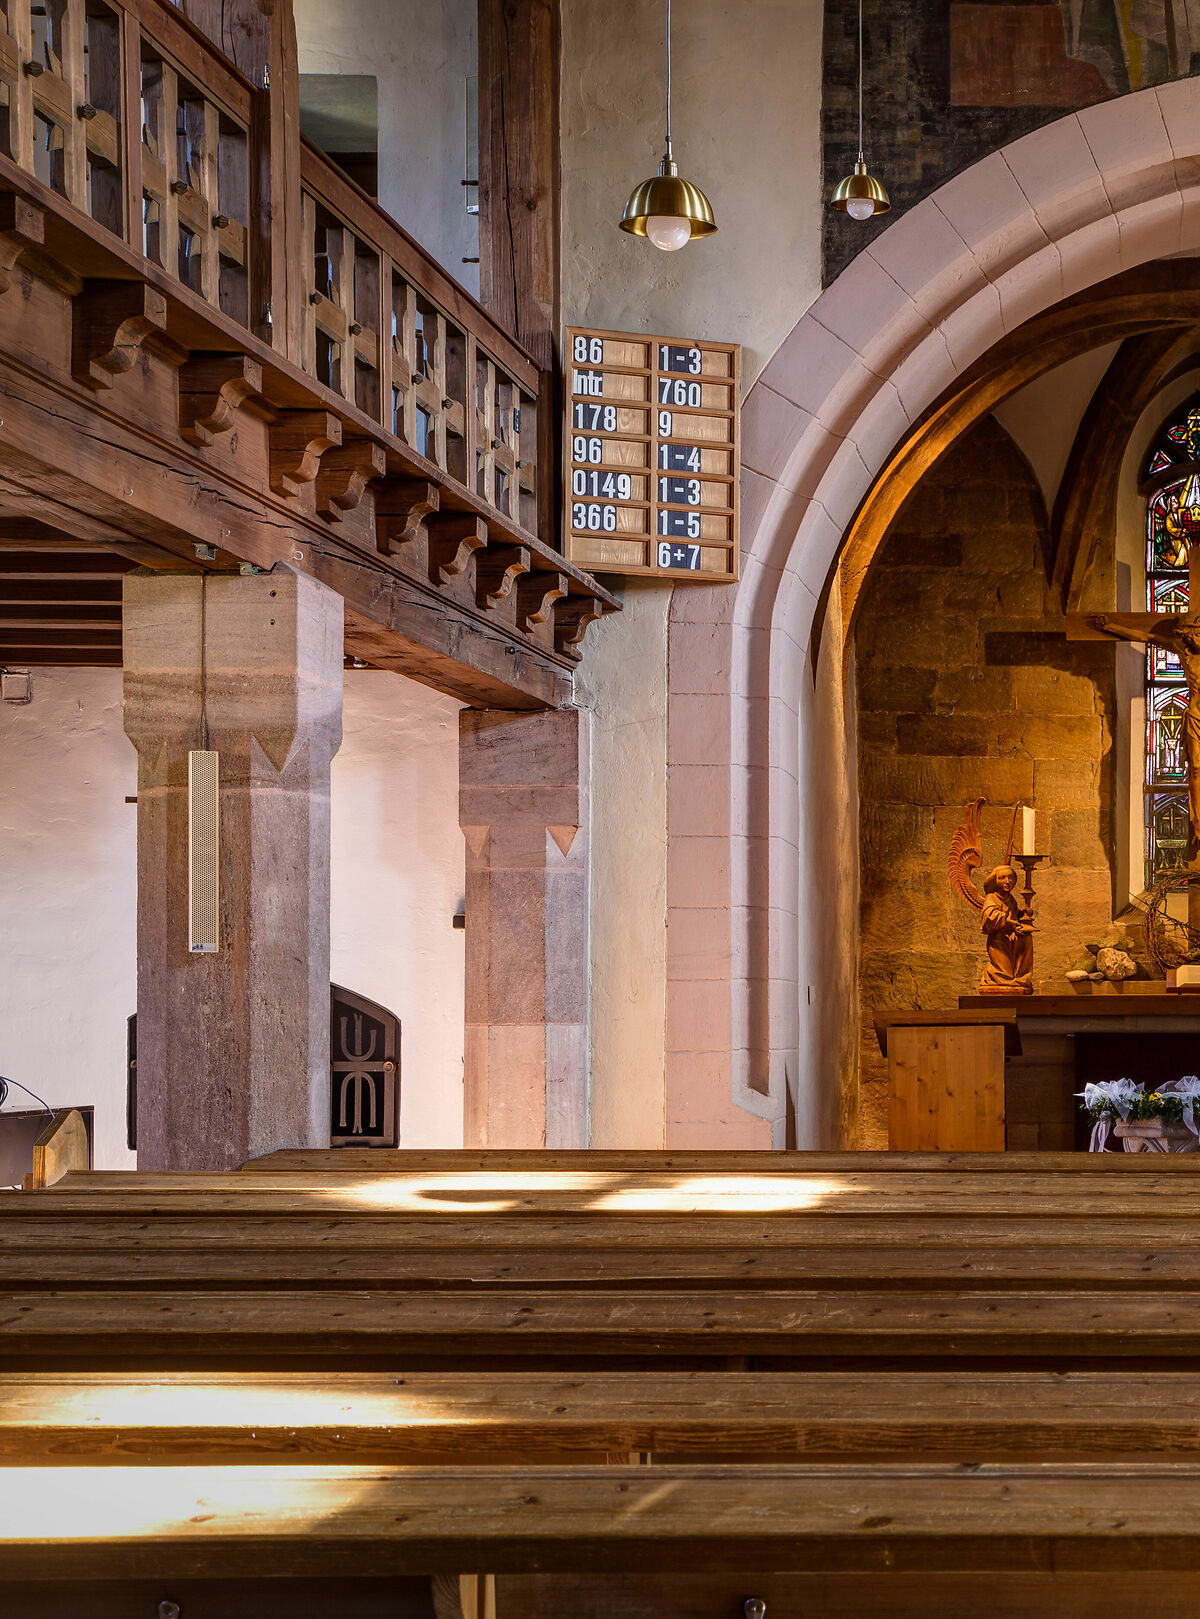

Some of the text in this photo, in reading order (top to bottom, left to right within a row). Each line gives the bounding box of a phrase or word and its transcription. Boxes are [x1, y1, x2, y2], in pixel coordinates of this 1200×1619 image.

[574, 336, 603, 364] 86
[659, 378, 701, 408] 760
[574, 403, 617, 431] 178
[658, 411, 673, 438] 9
[573, 436, 602, 464] 96
[573, 470, 631, 500] 0149
[572, 503, 616, 531] 366
